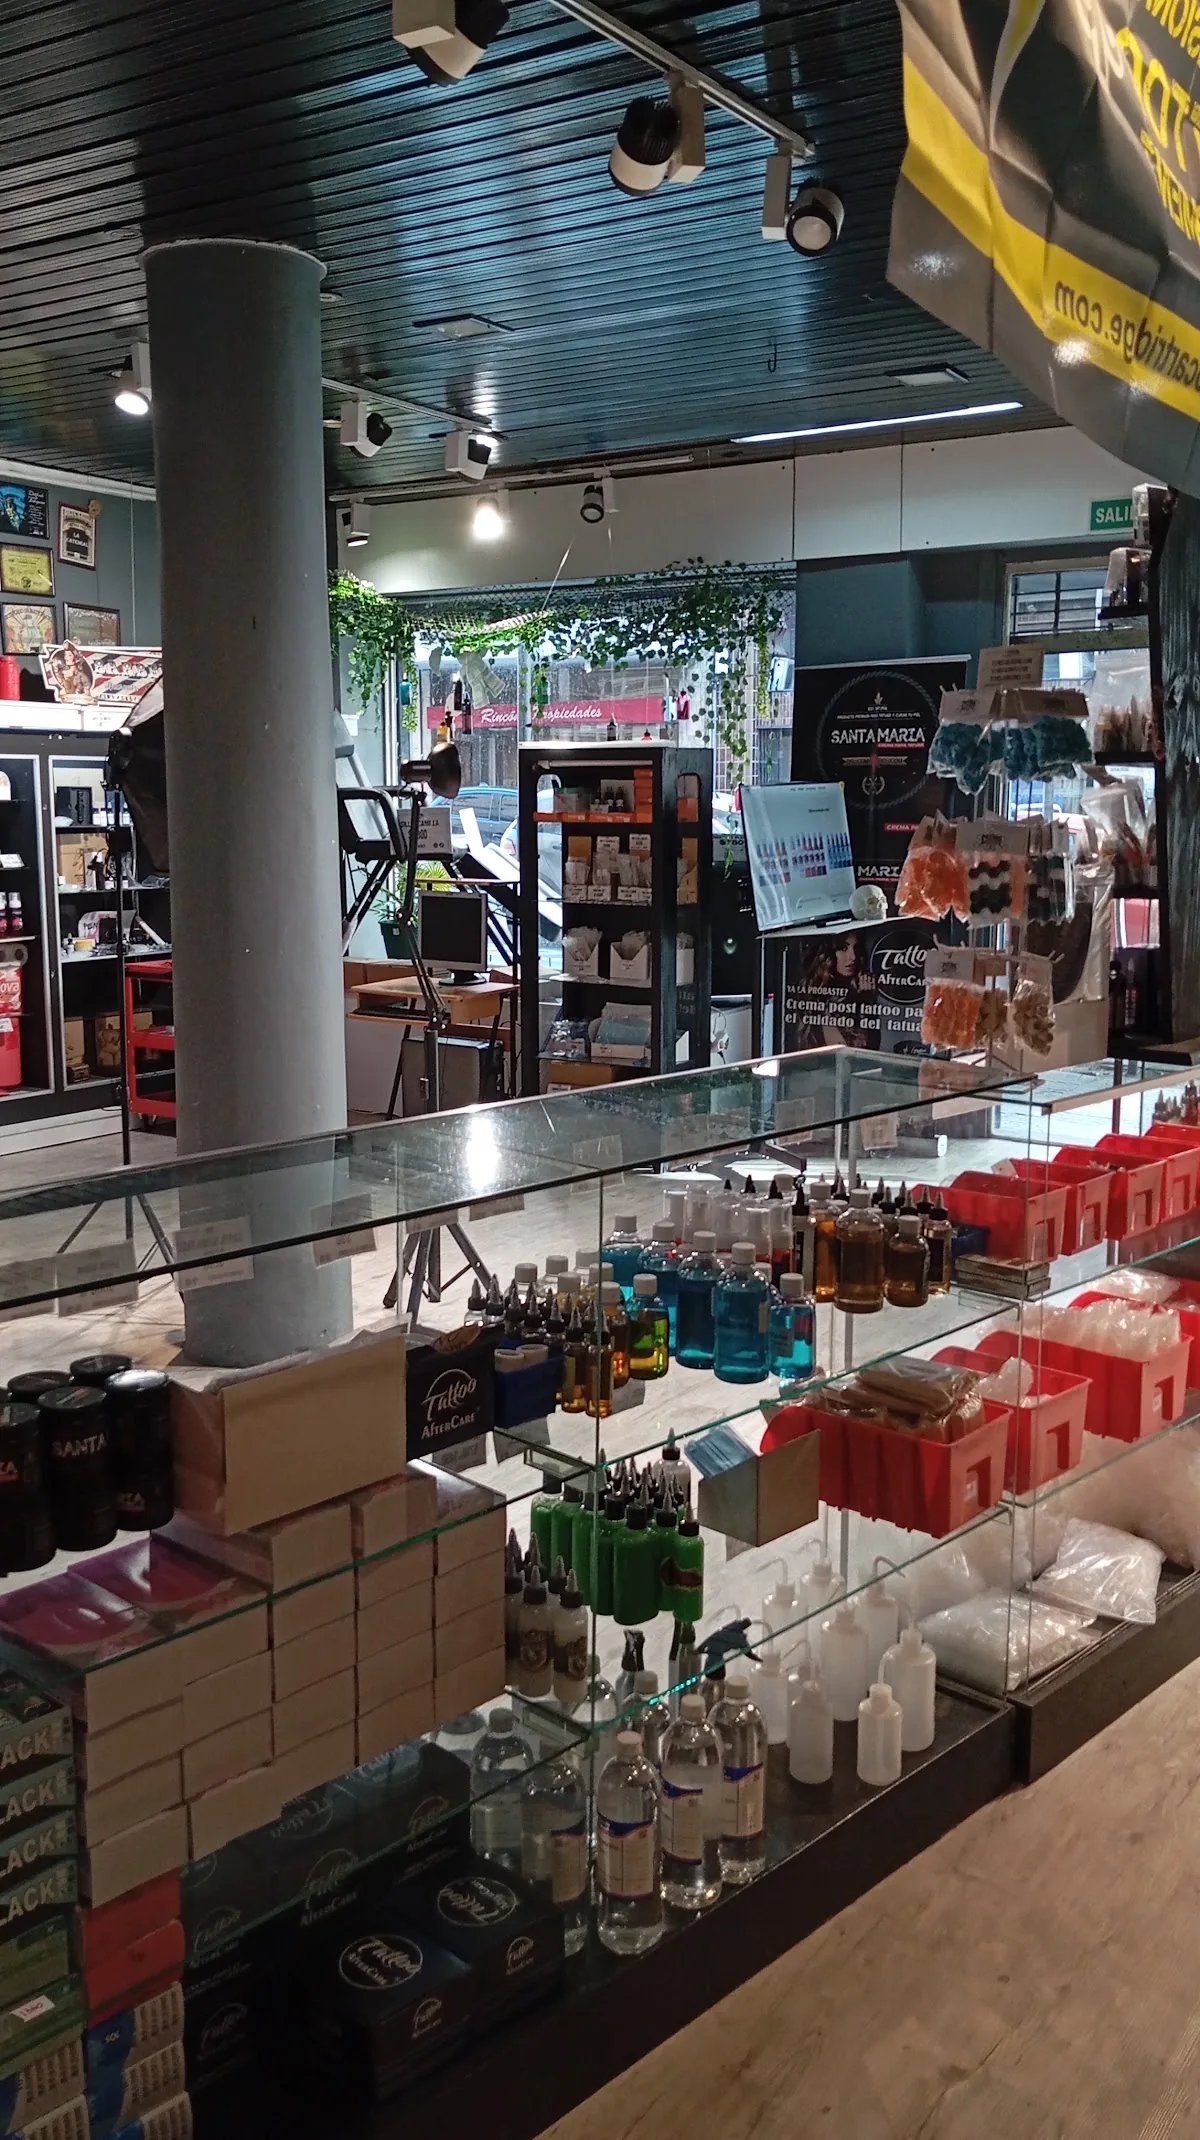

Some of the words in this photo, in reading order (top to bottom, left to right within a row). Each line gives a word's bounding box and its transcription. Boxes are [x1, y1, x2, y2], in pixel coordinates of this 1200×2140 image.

[1095, 505, 1136, 524] SALI
[831, 729, 875, 744] SANTA
[858, 865, 901, 877] MARI
[875, 944, 938, 971] Tatto
[786, 998, 825, 1012] Crema
[828, 1002, 857, 1014] post
[860, 1002, 901, 1017] tattoo
[784, 1013, 797, 1024] el
[802, 1015, 855, 1029] cuidado
[860, 1017, 881, 1031] del
[0, 1728, 50, 1771] ACK
